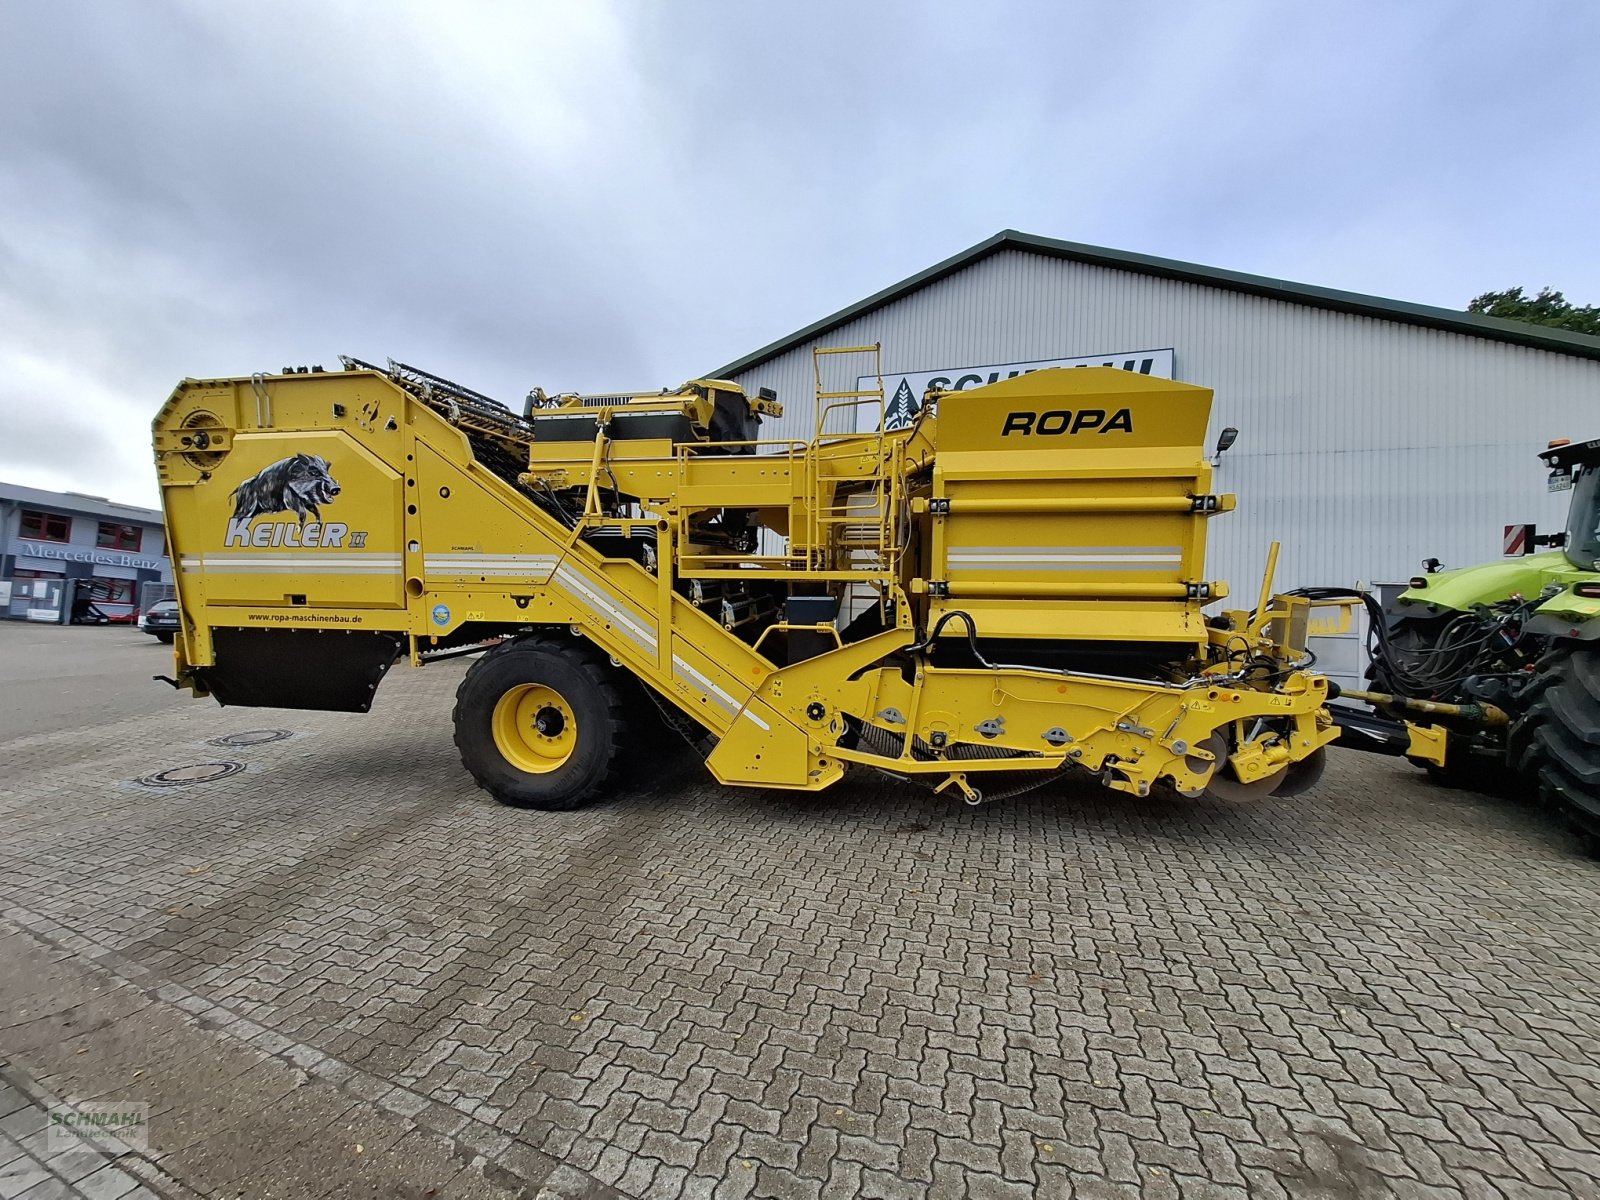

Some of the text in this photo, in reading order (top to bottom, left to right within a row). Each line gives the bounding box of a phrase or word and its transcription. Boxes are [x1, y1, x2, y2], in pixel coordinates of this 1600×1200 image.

[1001, 408, 1133, 436] ROPA
[224, 516, 368, 548] KEILER II
[248, 613, 363, 624] www.ropa-maschinenbau.de
